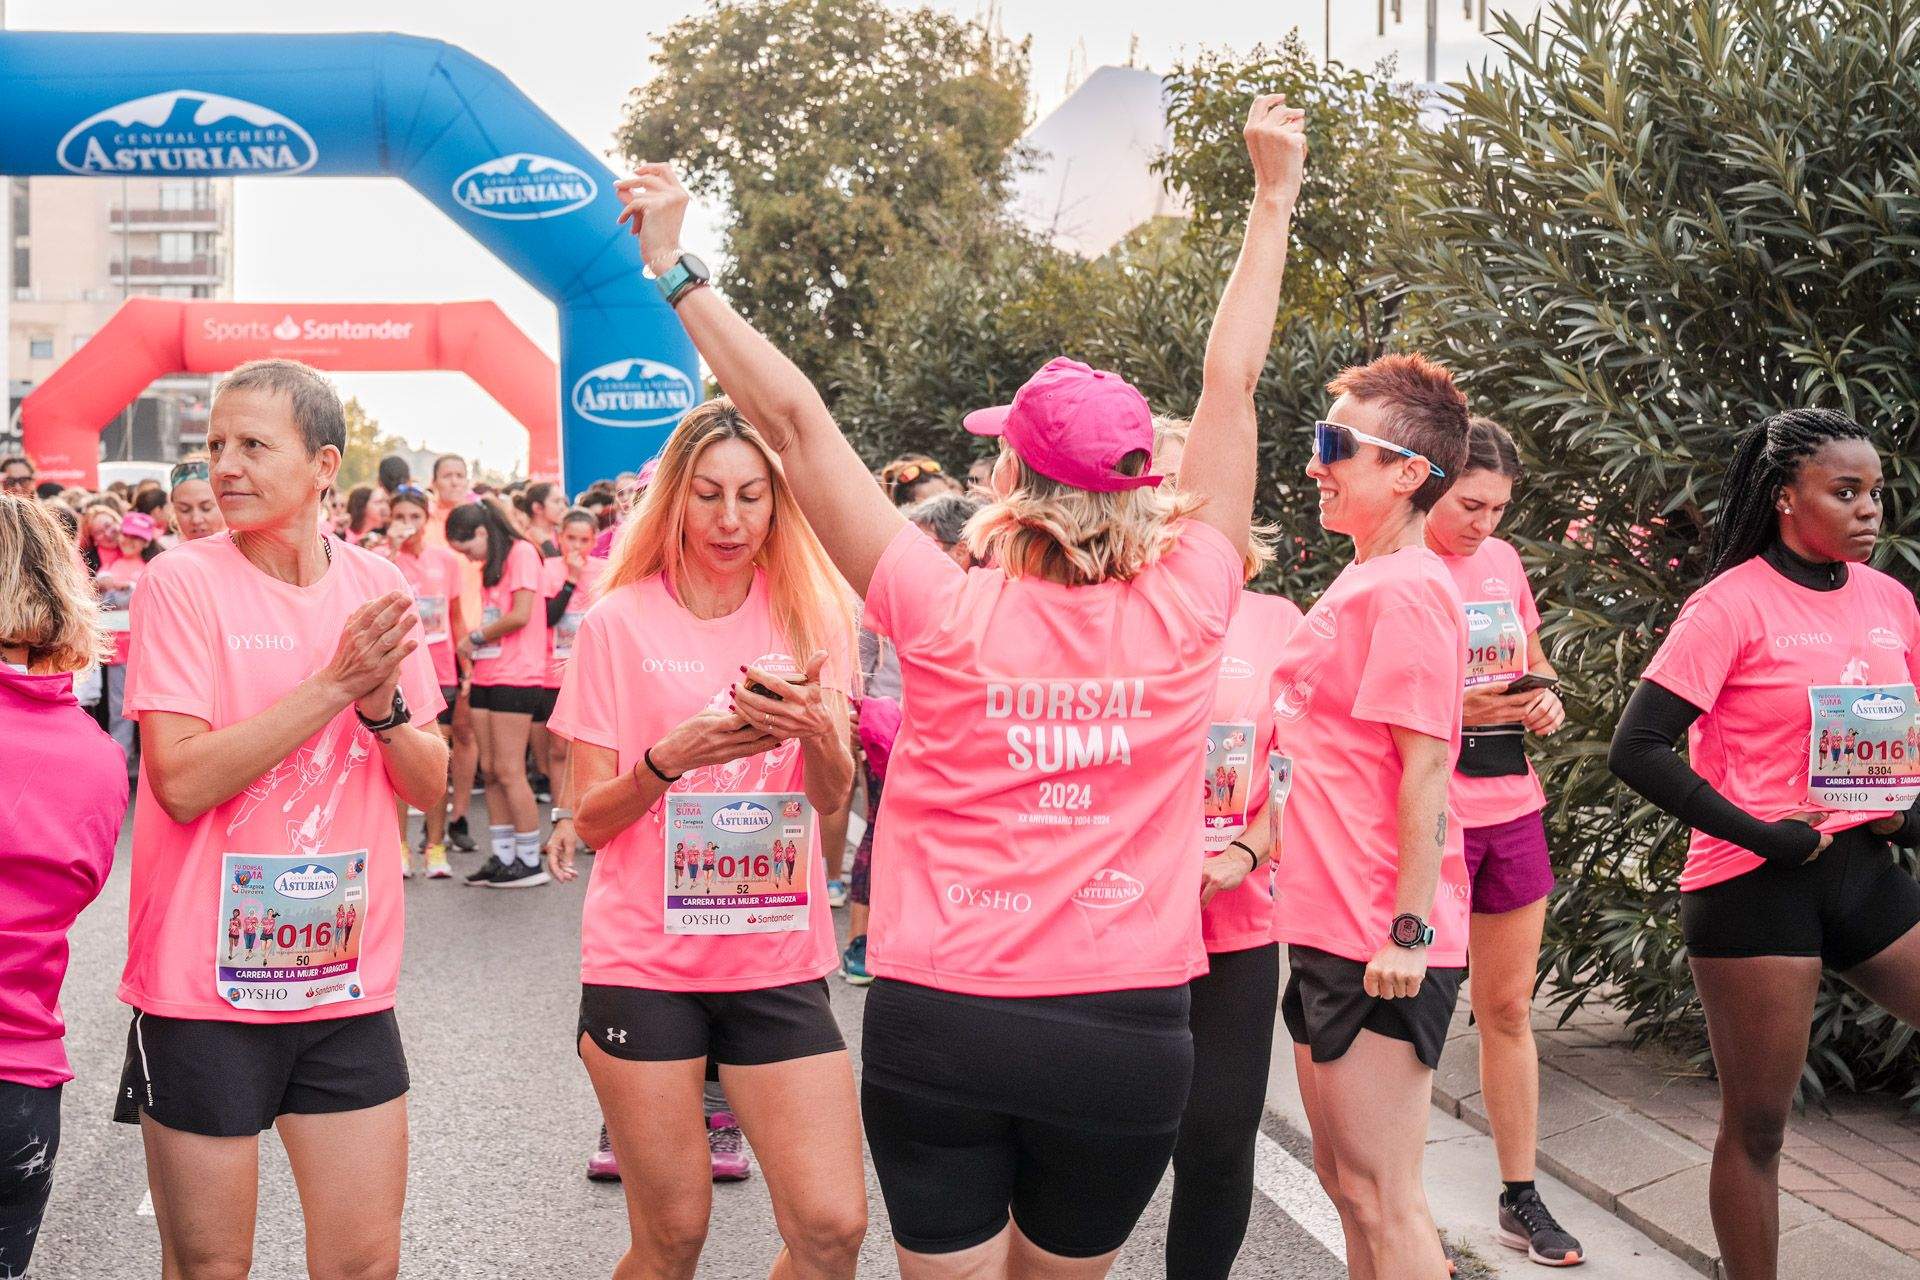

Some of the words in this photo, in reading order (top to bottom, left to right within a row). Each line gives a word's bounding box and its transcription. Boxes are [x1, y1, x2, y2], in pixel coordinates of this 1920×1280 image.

[113, 132, 197, 145] CENTRAL
[203, 130, 287, 143] LECHERA
[83, 136, 300, 170] ASTURIANA
[464, 180, 588, 205] ASTURIANA
[203, 317, 271, 343] Sports
[303, 318, 414, 341] Santander
[582, 384, 689, 411] ASTURIANA
[227, 633, 295, 652] OYSHO
[1775, 631, 1833, 648] OYSHO
[642, 658, 705, 673] OYSHO
[985, 680, 1152, 721] DORSAL
[1856, 703, 1903, 714] ASTURIANA
[1007, 724, 1132, 774] SUMA
[1857, 740, 1904, 760] 016
[1868, 766, 1892, 775] 8304
[1825, 777, 1854, 785] CARRERA
[1856, 777, 1864, 785] DE
[1866, 777, 1874, 785] LA
[1875, 777, 1897, 785] MUJER
[1038, 782, 1092, 810] 2024
[1824, 792, 1868, 802] OYSHO
[676, 808, 702, 816] SUMA
[716, 813, 769, 825] ASTURIANA
[718, 854, 769, 878] 016
[280, 877, 334, 891] ASTURIANA
[737, 884, 749, 894] 52
[682, 898, 716, 906] CARRERA
[727, 897, 736, 905] LA
[738, 897, 759, 905] MUJER
[765, 895, 797, 904] ZARAGOZA
[947, 884, 1032, 913] OYSHO
[682, 914, 731, 925] OYSHO
[758, 913, 794, 924] Santander
[277, 922, 332, 949] 016
[296, 955, 310, 966] 50
[235, 970, 272, 979] CARRERA
[273, 970, 283, 978] DE
[285, 970, 295, 978] LA
[297, 968, 319, 978] MUJER
[322, 963, 349, 975] ZARAGOZA
[315, 982, 346, 997] Santander
